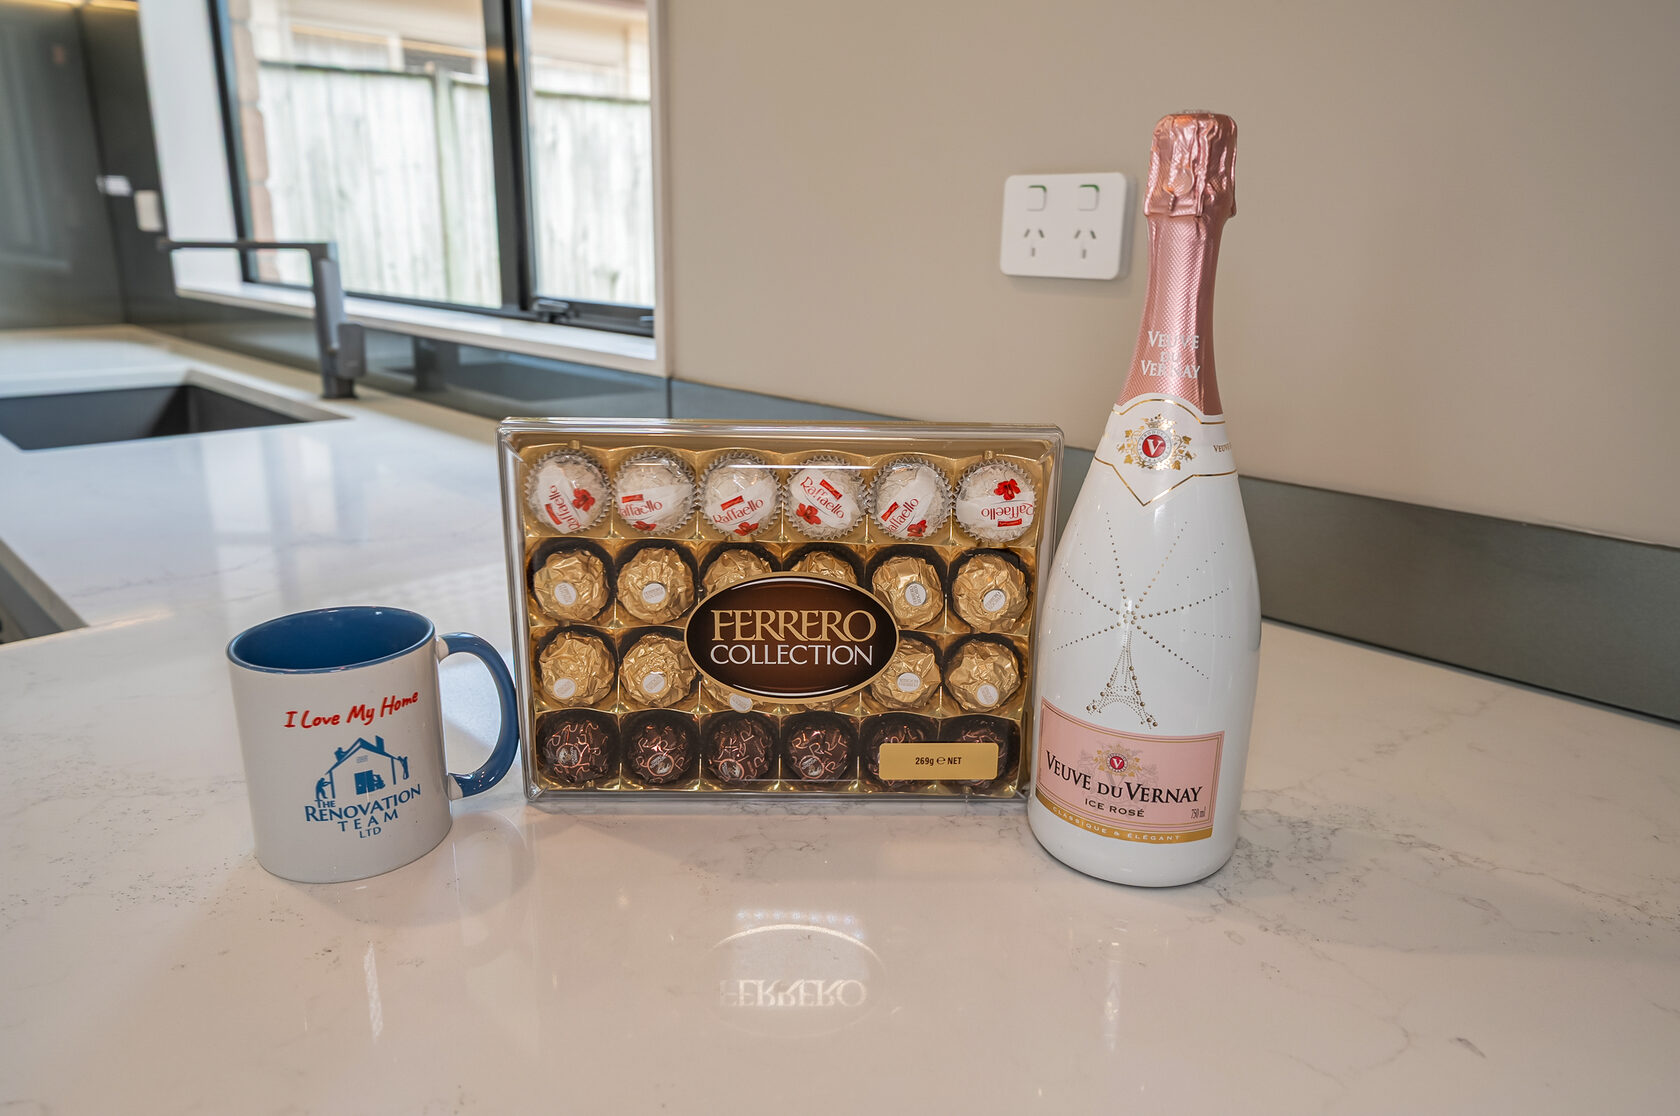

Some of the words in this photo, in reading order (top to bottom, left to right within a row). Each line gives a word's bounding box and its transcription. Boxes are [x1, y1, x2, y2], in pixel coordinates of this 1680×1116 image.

[1147, 330, 1200, 349] VEUVE
[1146, 438, 1164, 457] V
[618, 499, 663, 517] affaello
[800, 476, 845, 519] Raffaello
[886, 498, 919, 533] affaello
[710, 609, 877, 643] FERRERO
[710, 644, 873, 666] COLLECTION
[284, 710, 298, 729] I
[301, 710, 341, 729] Love
[346, 704, 374, 726] My
[380, 691, 419, 718] Home
[915, 757, 935, 766] 269g
[947, 757, 962, 765] NET
[1046, 749, 1092, 791] VEUVE
[1097, 781, 1122, 799] DU
[1124, 781, 1203, 804] VERNAY
[304, 783, 421, 822] RENOVATION
[315, 799, 336, 809] THE
[1085, 798, 1105, 811] ICE
[1109, 803, 1145, 818] ROSÉ
[338, 808, 399, 832] TEAM
[359, 826, 382, 839] LTD
